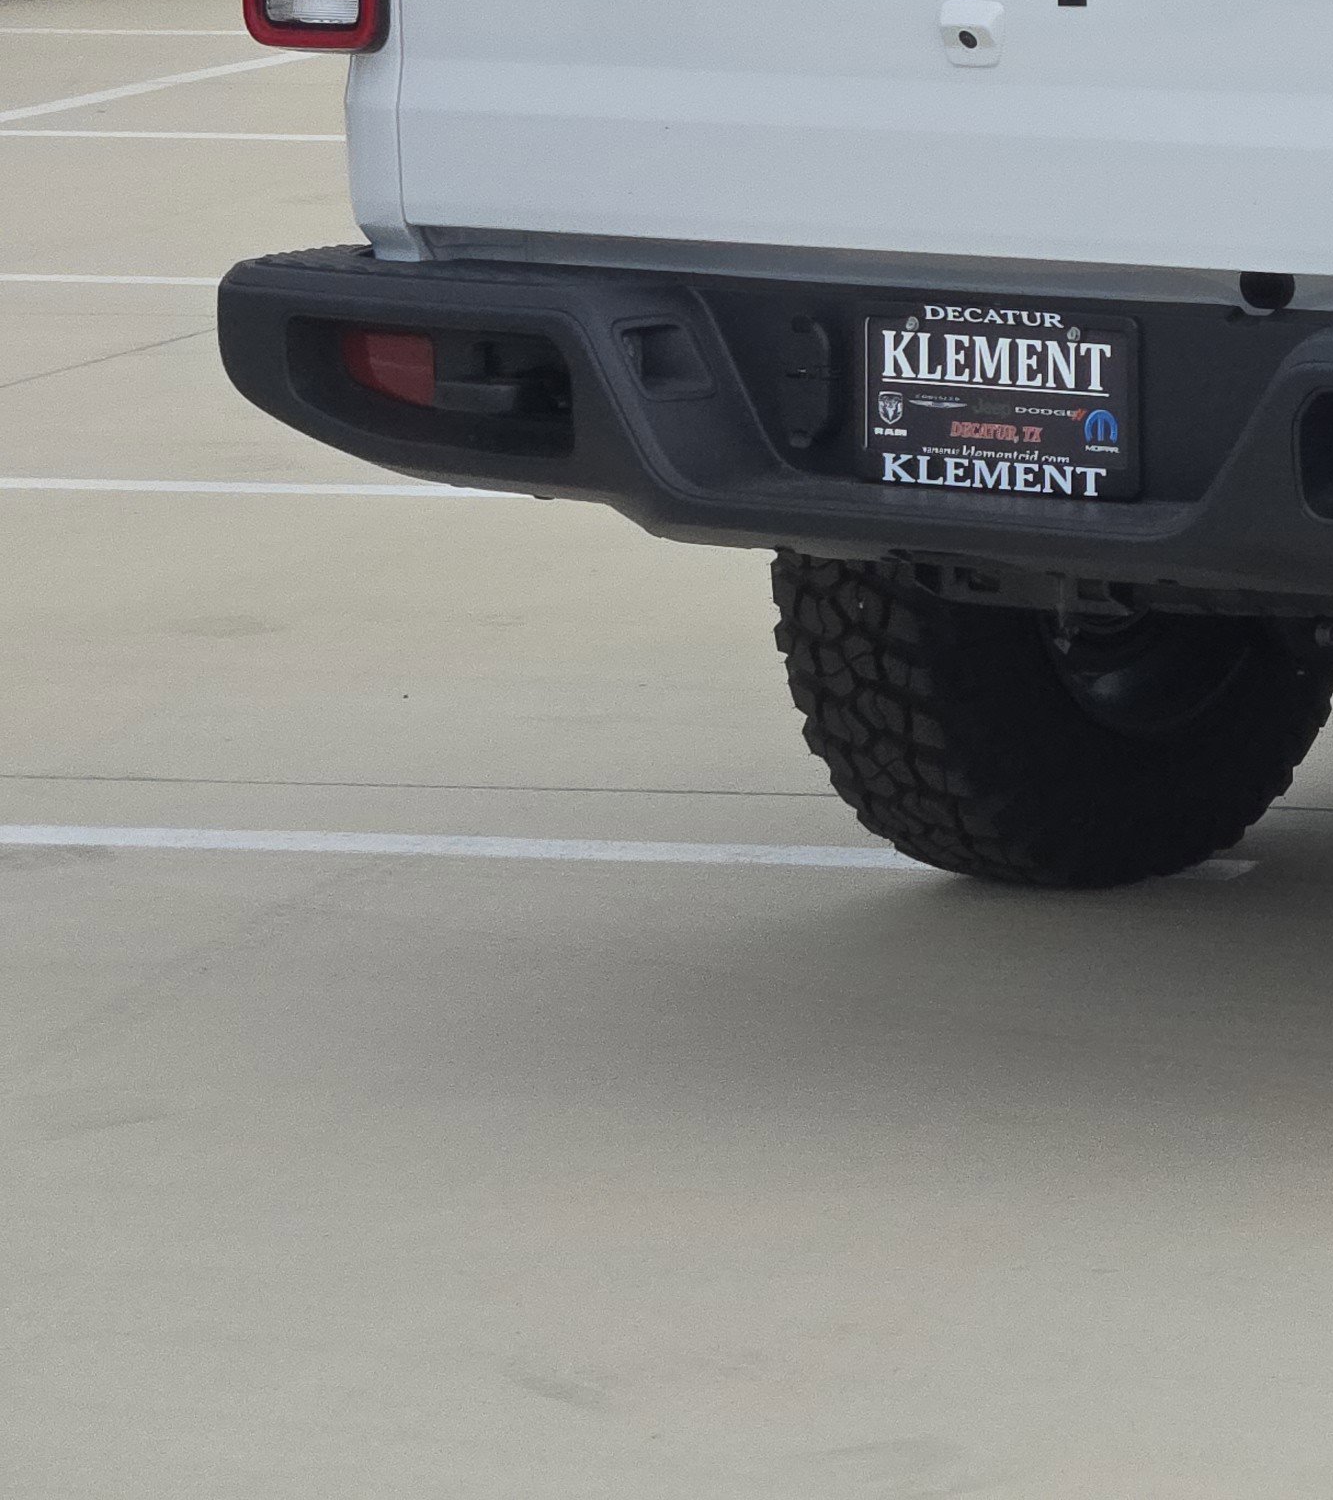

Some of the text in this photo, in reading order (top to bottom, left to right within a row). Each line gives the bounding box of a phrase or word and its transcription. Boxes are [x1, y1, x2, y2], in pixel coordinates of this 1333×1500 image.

[923, 305, 1064, 329] DECATUR
[881, 329, 1112, 391] KLEMENT
[881, 452, 1107, 497] KLEMENT
